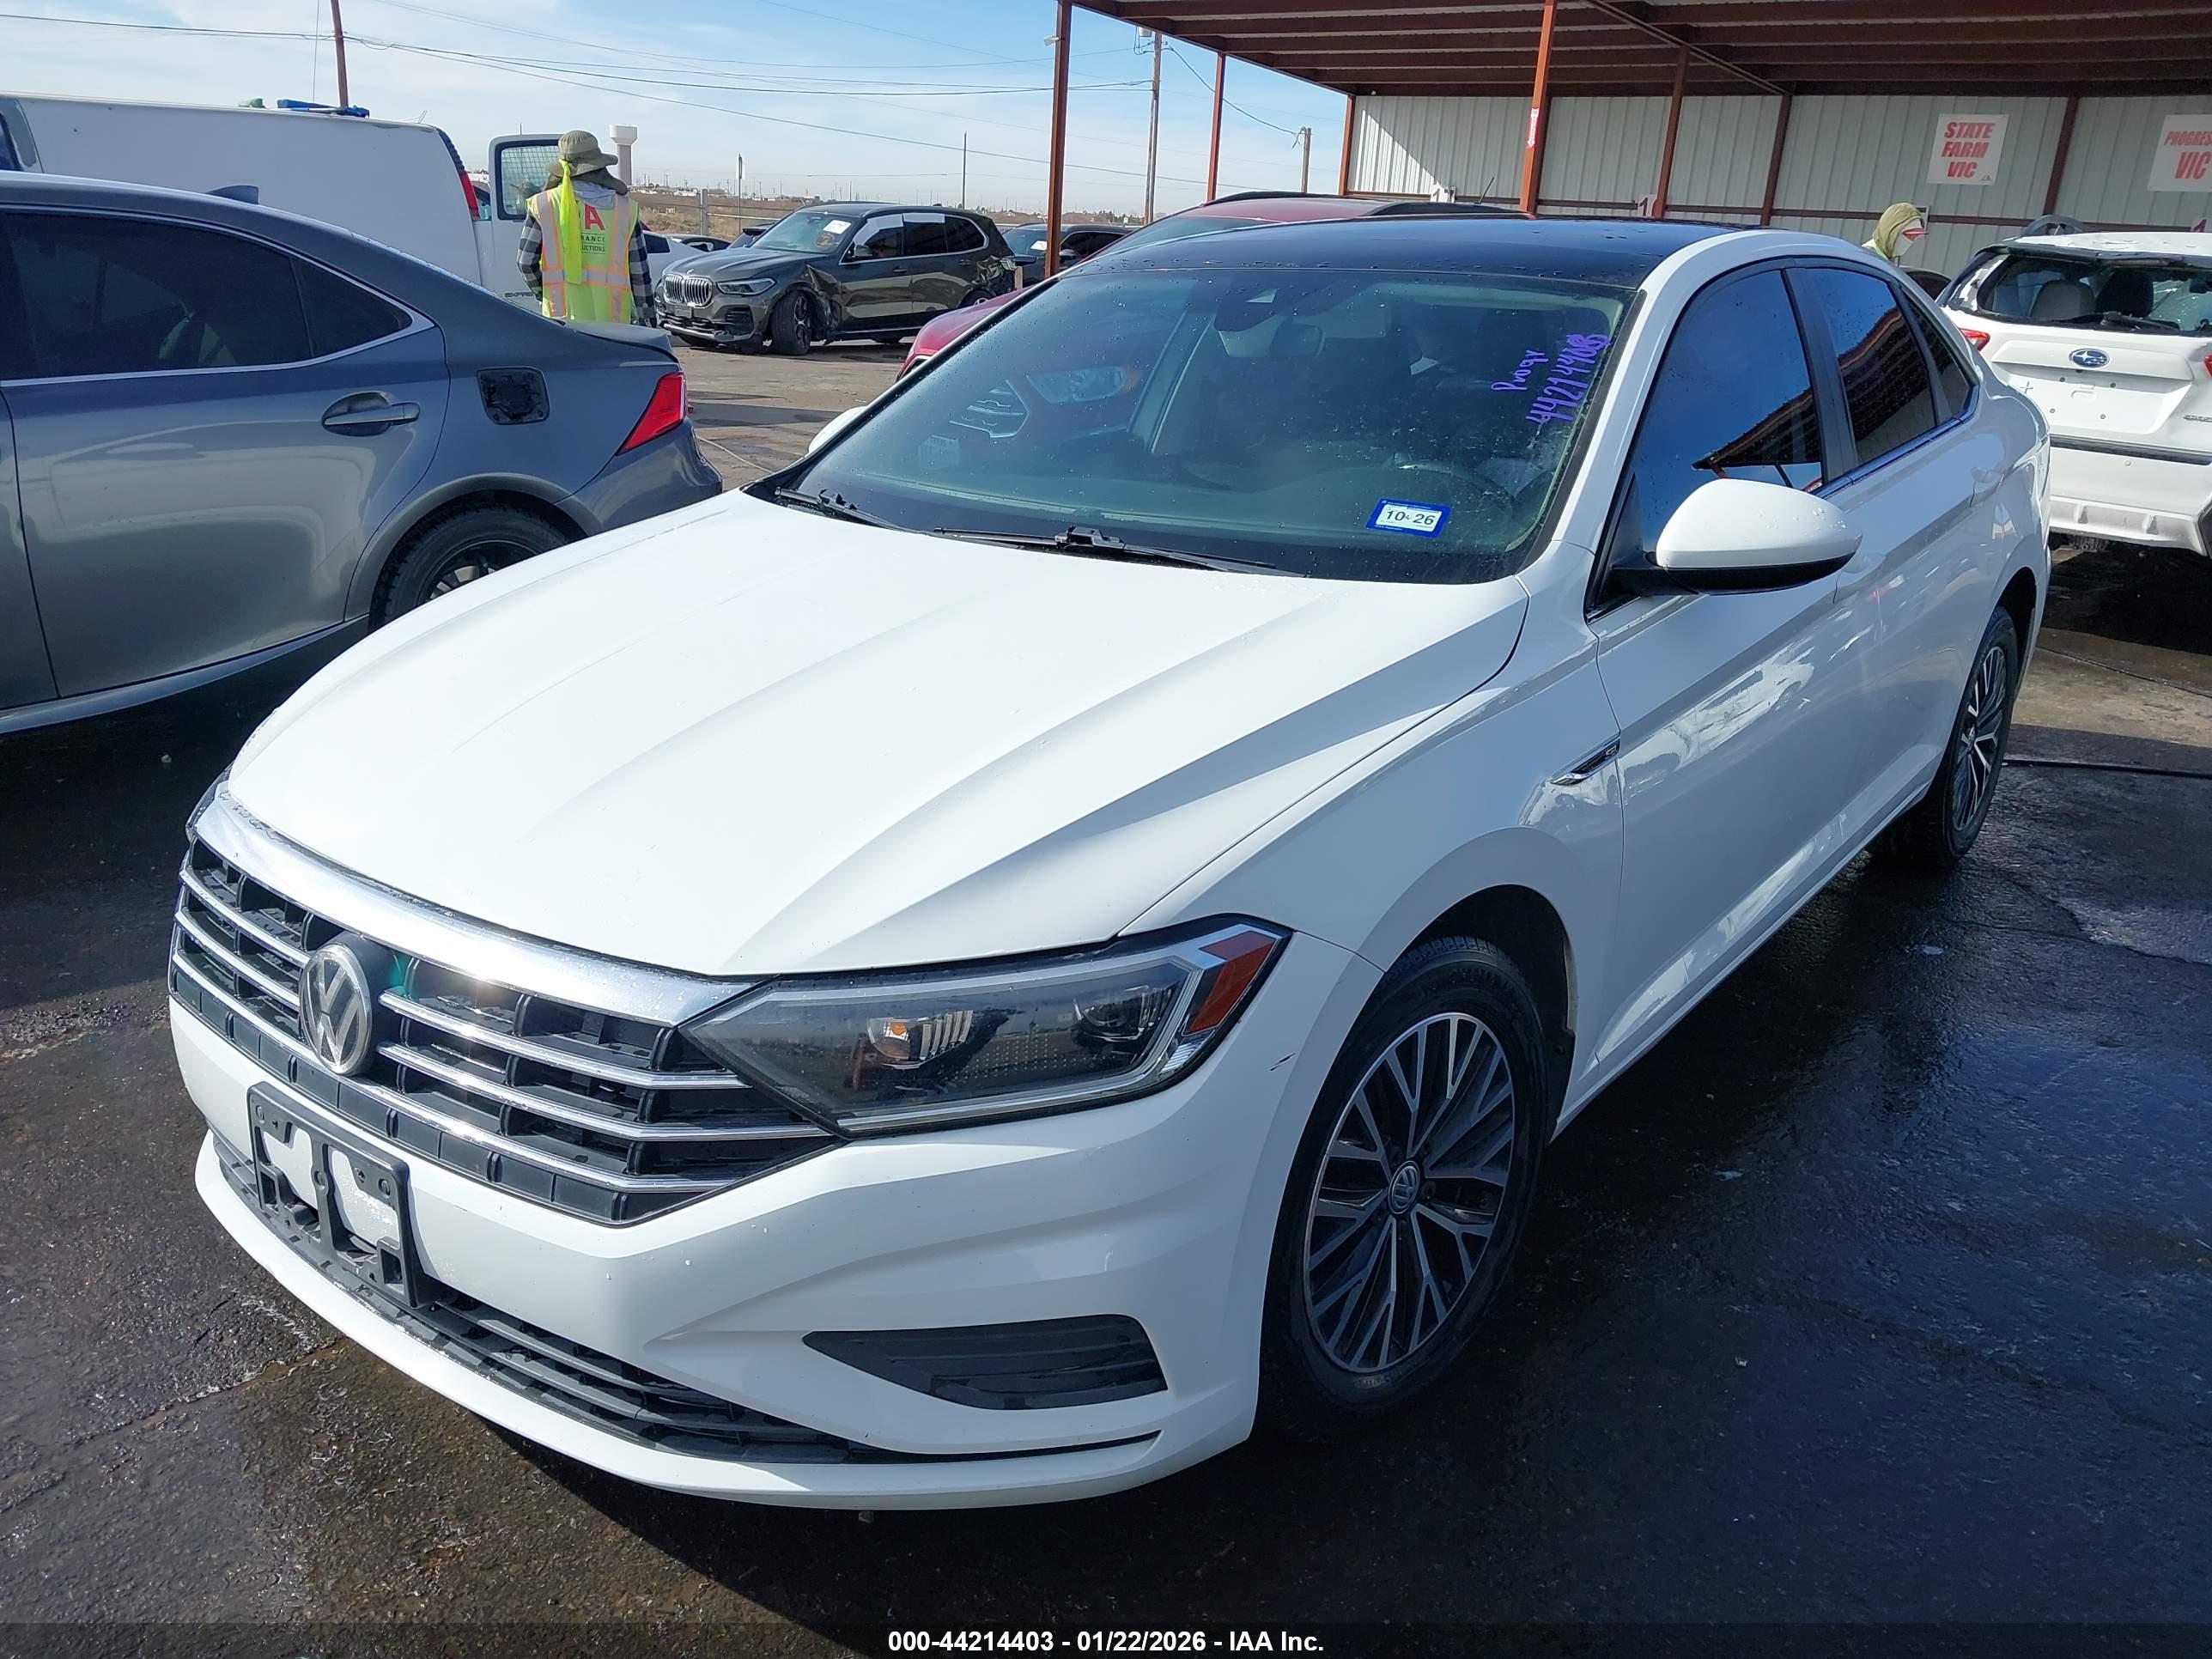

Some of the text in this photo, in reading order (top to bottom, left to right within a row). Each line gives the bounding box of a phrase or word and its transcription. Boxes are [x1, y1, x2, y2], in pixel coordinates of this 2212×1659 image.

[1944, 122, 1995, 138] STATE
[1942, 142, 1990, 158] FARM
[1948, 161, 1978, 178] VIC
[2175, 151, 2212, 179] VIC
[1386, 510, 1436, 526] 10 26
